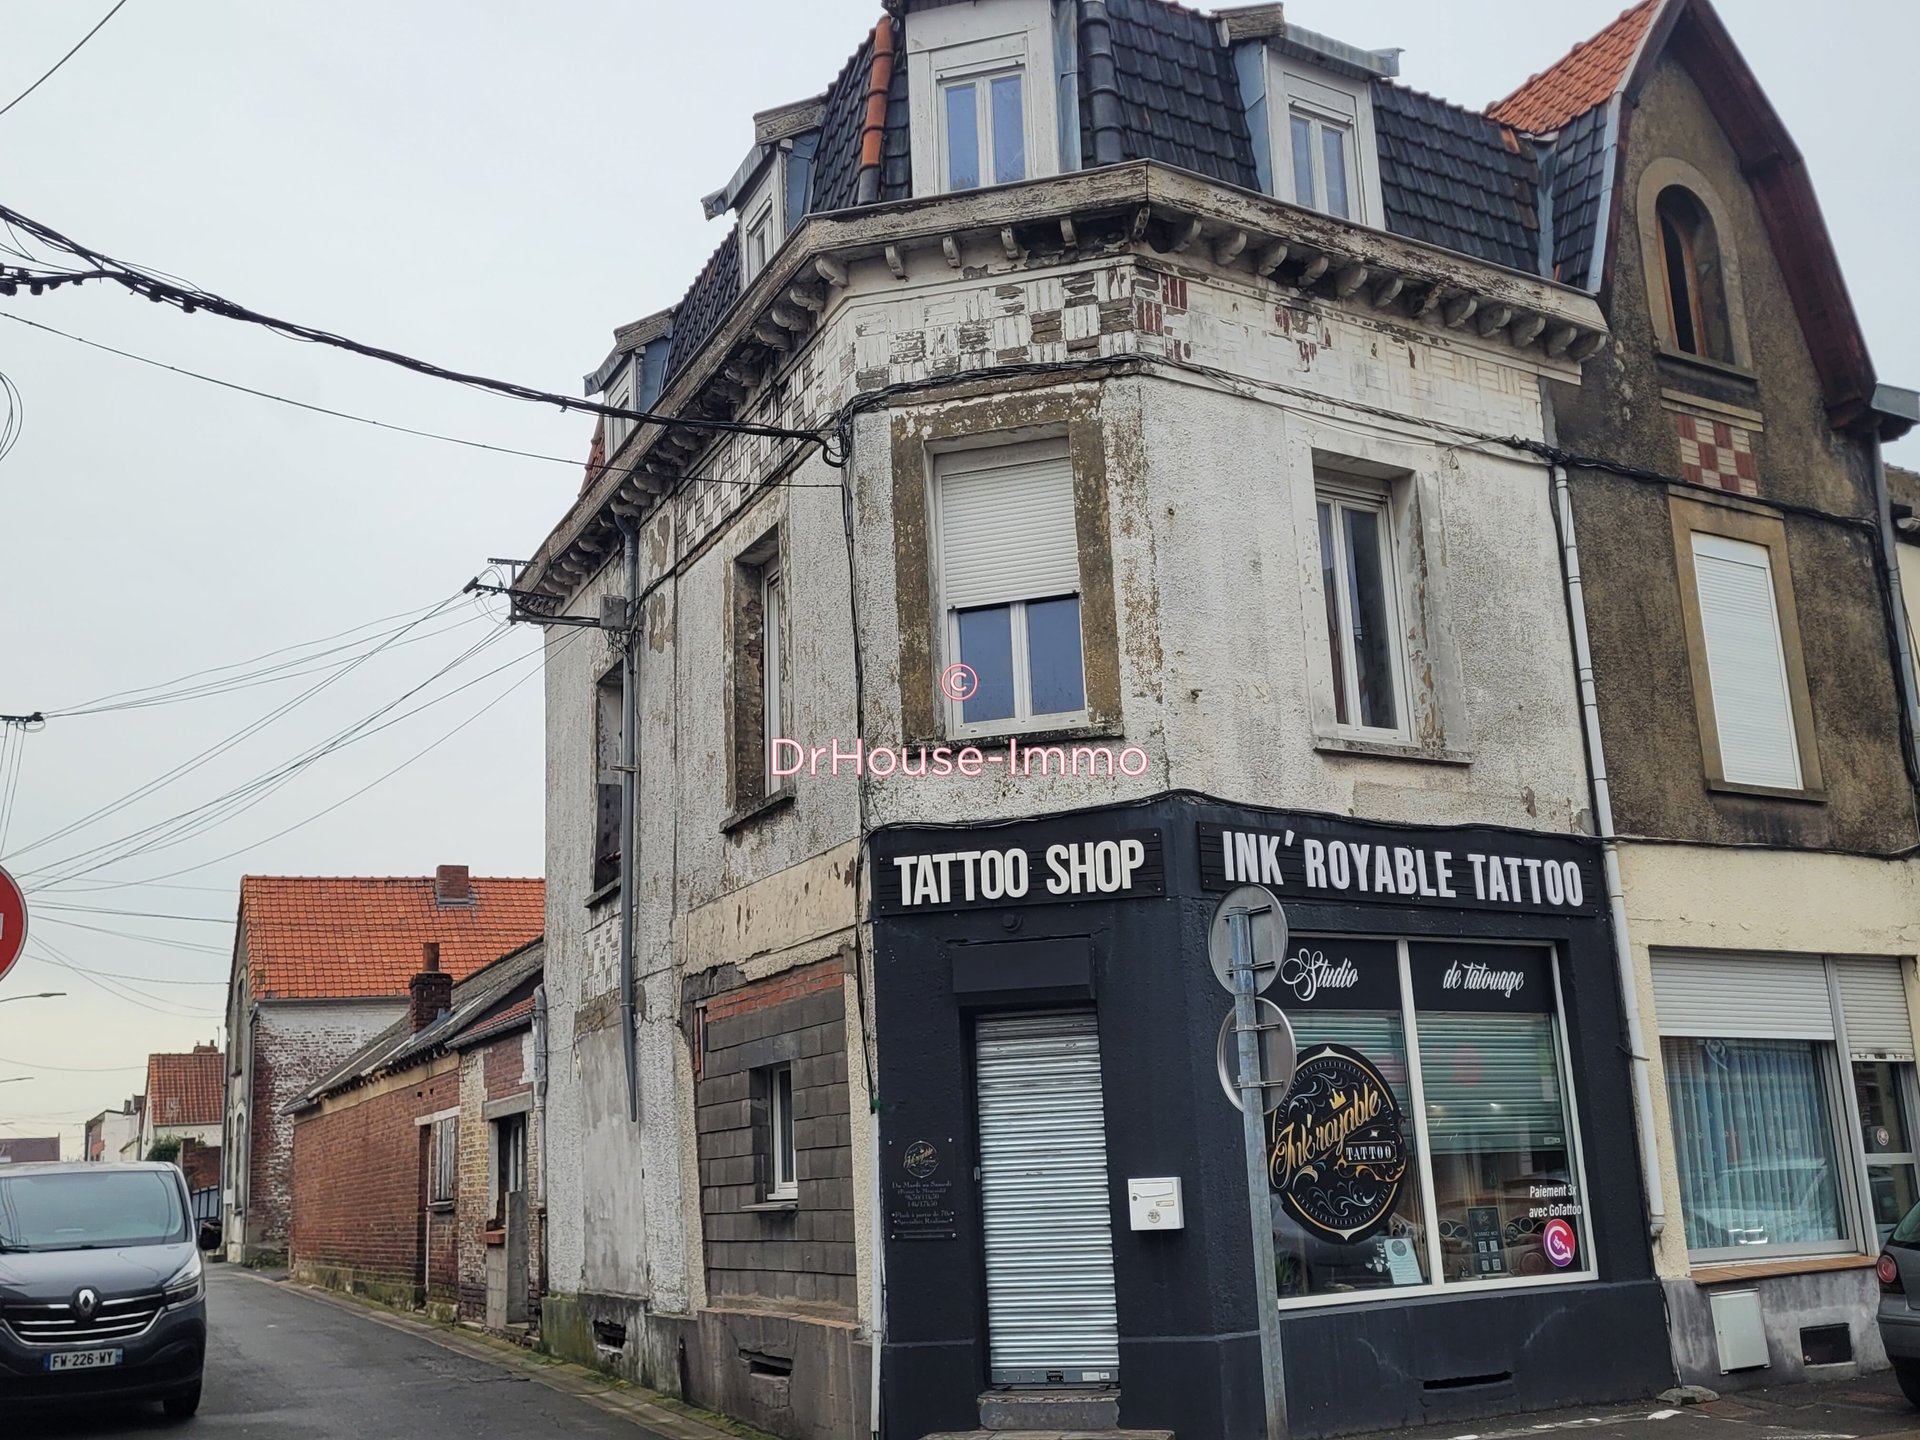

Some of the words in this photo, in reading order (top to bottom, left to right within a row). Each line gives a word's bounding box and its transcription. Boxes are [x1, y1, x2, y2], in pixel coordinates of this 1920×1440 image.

[893, 848, 1029, 906] TATTOO
[1045, 839, 1145, 894] SHOP
[1303, 838, 1457, 898] ROYABLE
[1467, 853, 1584, 907] TATTOO
[1281, 948, 1358, 1001] Studio
[1443, 960, 1461, 990] de
[1461, 962, 1525, 998] tatouage
[1345, 1145, 1392, 1162] TATTOO
[1529, 1185, 1567, 1199] Paiement
[1567, 1184, 1577, 1197] 3x
[1529, 1206, 1548, 1218] avec
[1549, 1203, 1582, 1217] GoTattoo
[52, 1350, 114, 1368] FW-226-WY
